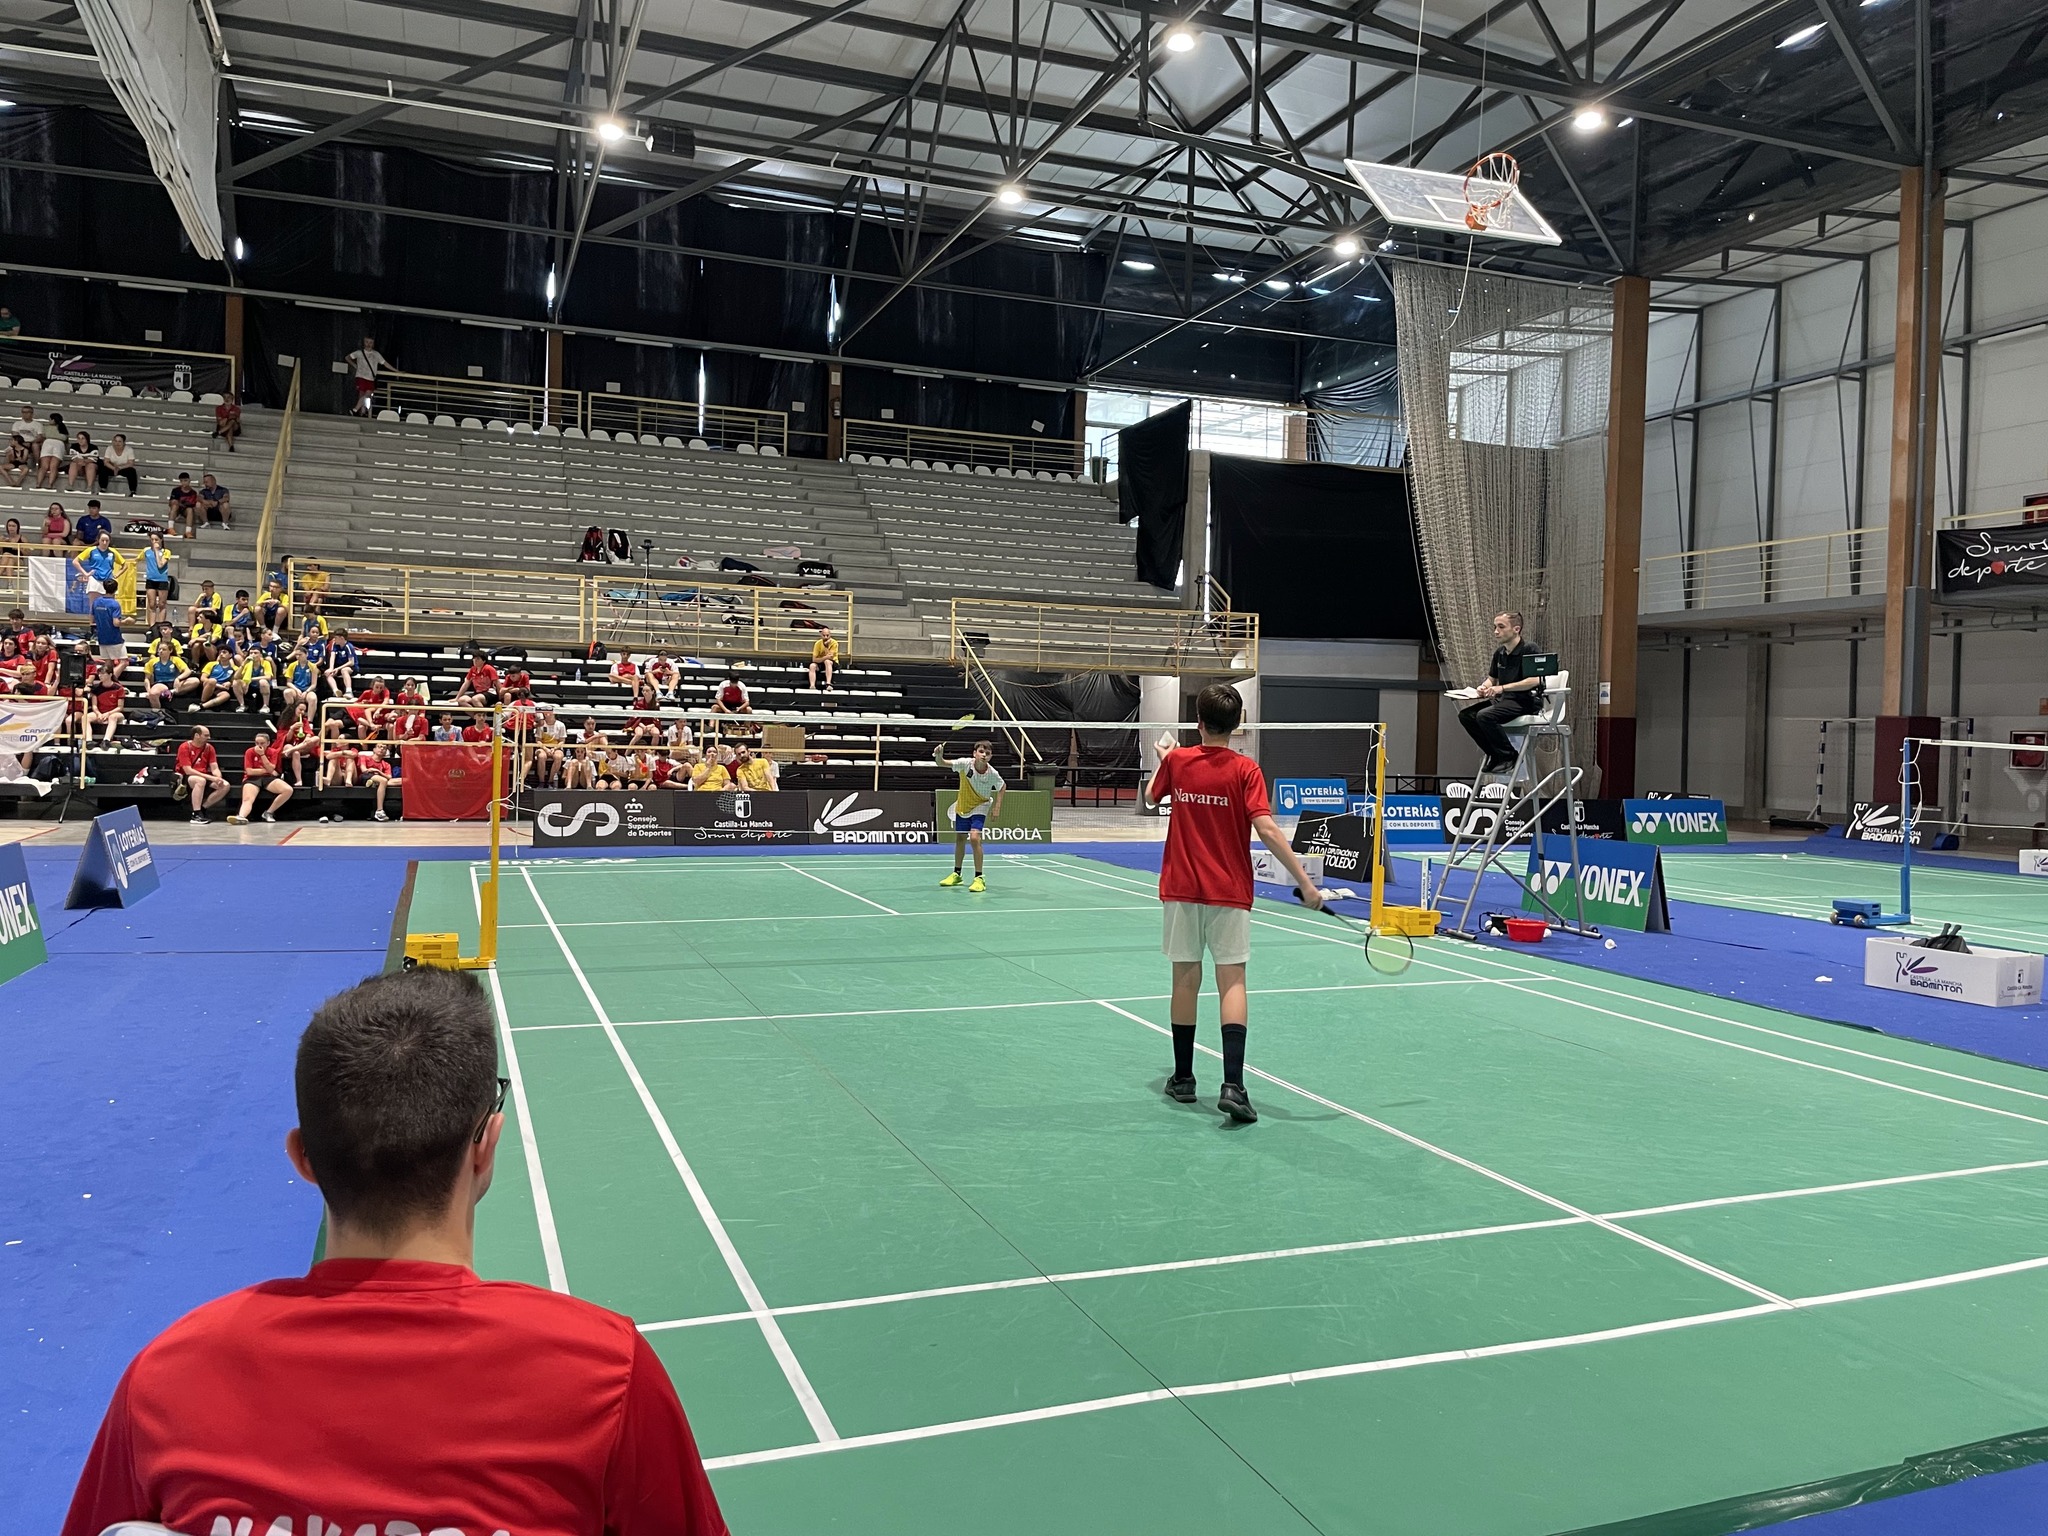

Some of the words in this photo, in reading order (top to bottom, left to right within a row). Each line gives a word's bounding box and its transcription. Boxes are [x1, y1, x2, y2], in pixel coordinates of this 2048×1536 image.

[1966, 532, 2048, 557] Somos
[1299, 785, 1345, 796] LOTERÍAS
[1174, 788, 1229, 807] Navarra
[1382, 804, 1439, 818] LOTERÍAS
[627, 815, 657, 825] Consejo
[749, 820, 773, 828] Mancha
[893, 820, 928, 829] ESPAÑA
[1665, 812, 1720, 833] YONEX
[627, 823, 659, 832] Superior
[118, 824, 146, 852] LOTERÍAS
[638, 830, 672, 838] Deportes
[832, 831, 929, 843] BADMINTON
[1861, 832, 1920, 845] BADMINTN
[1352, 850, 1360, 859] DE
[1325, 854, 1357, 870] TOLEDO
[1910, 979, 1963, 994] BADMINTON
